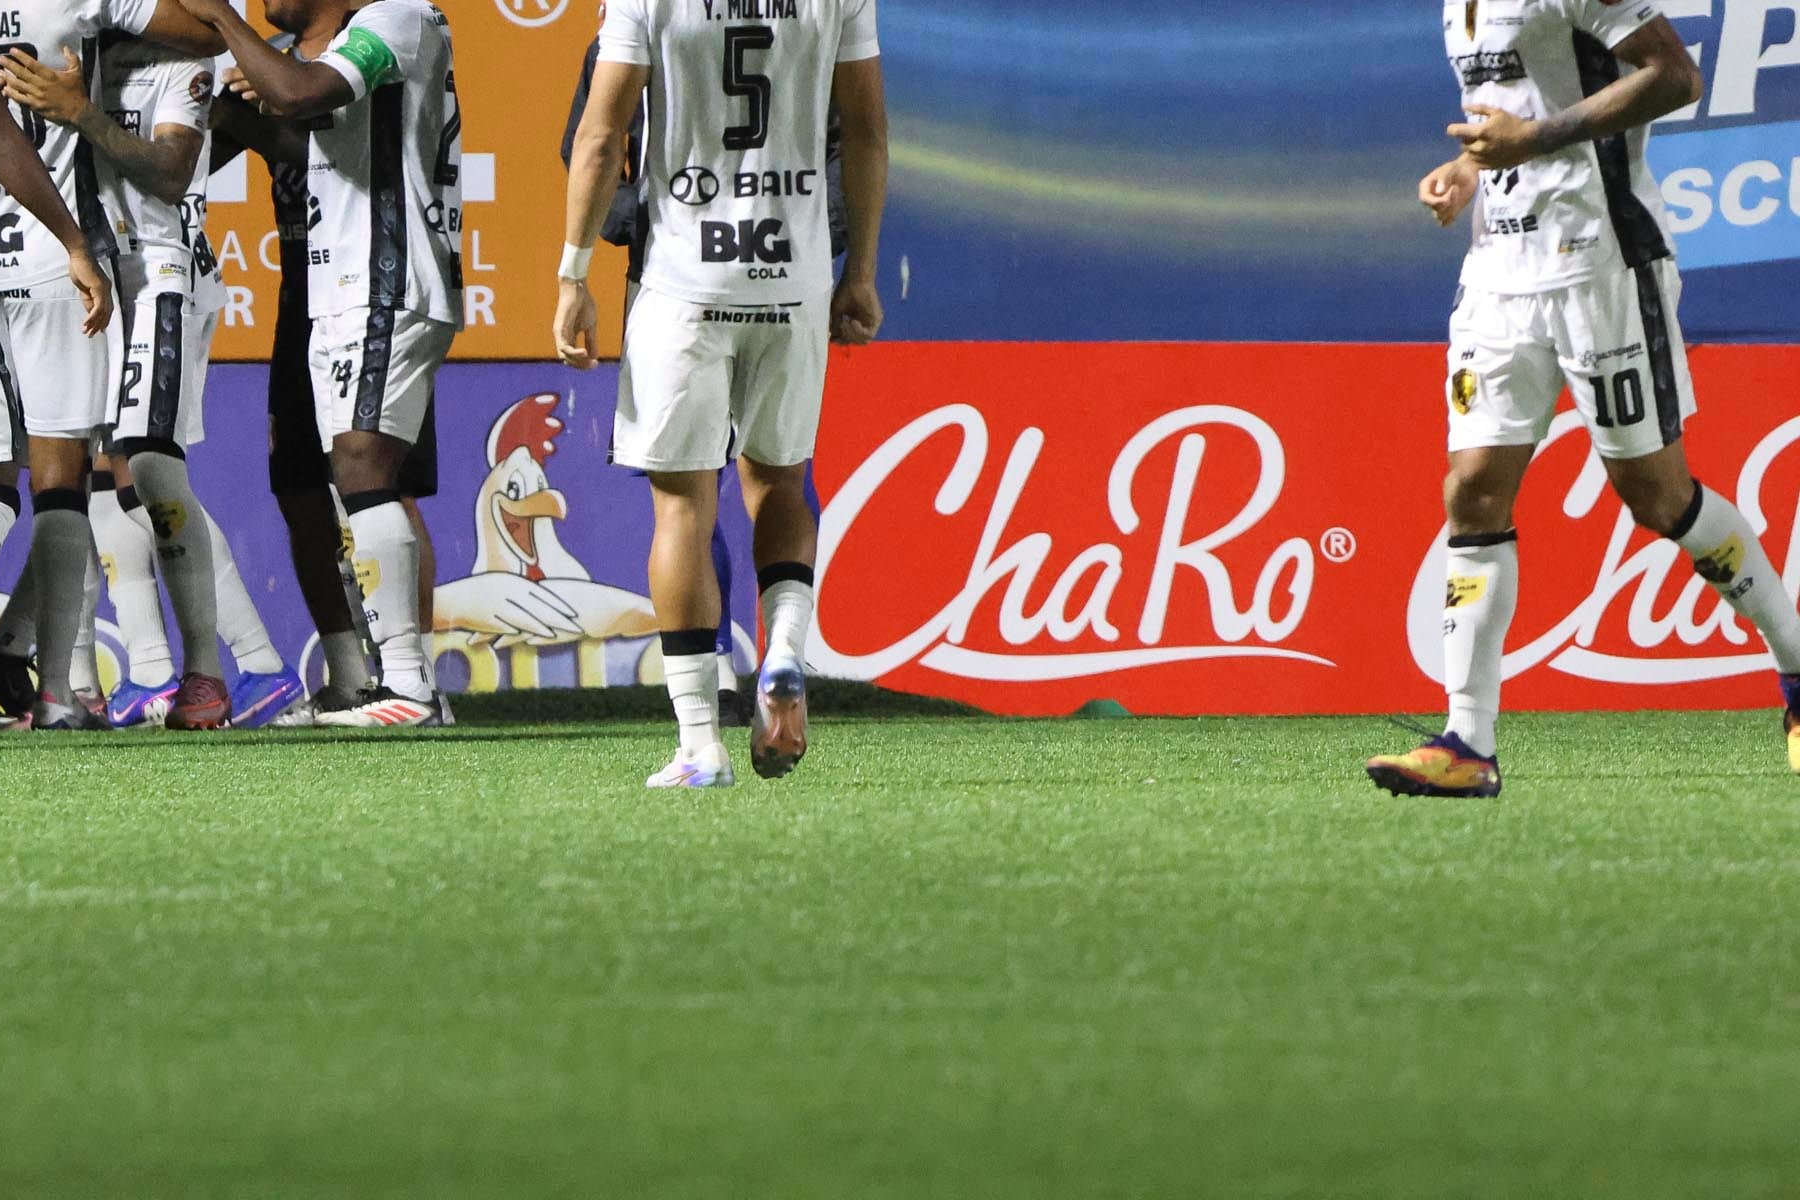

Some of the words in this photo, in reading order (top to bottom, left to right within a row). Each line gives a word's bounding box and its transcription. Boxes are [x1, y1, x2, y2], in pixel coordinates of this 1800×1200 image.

[722, 25, 774, 151] 5
[733, 169, 817, 198] BAIC
[700, 218, 792, 263] BIG
[747, 266, 788, 280] COLA
[703, 308, 791, 324] SINOTRUK
[1588, 368, 1645, 428] 10
[803, 403, 1320, 681] ChaRo
